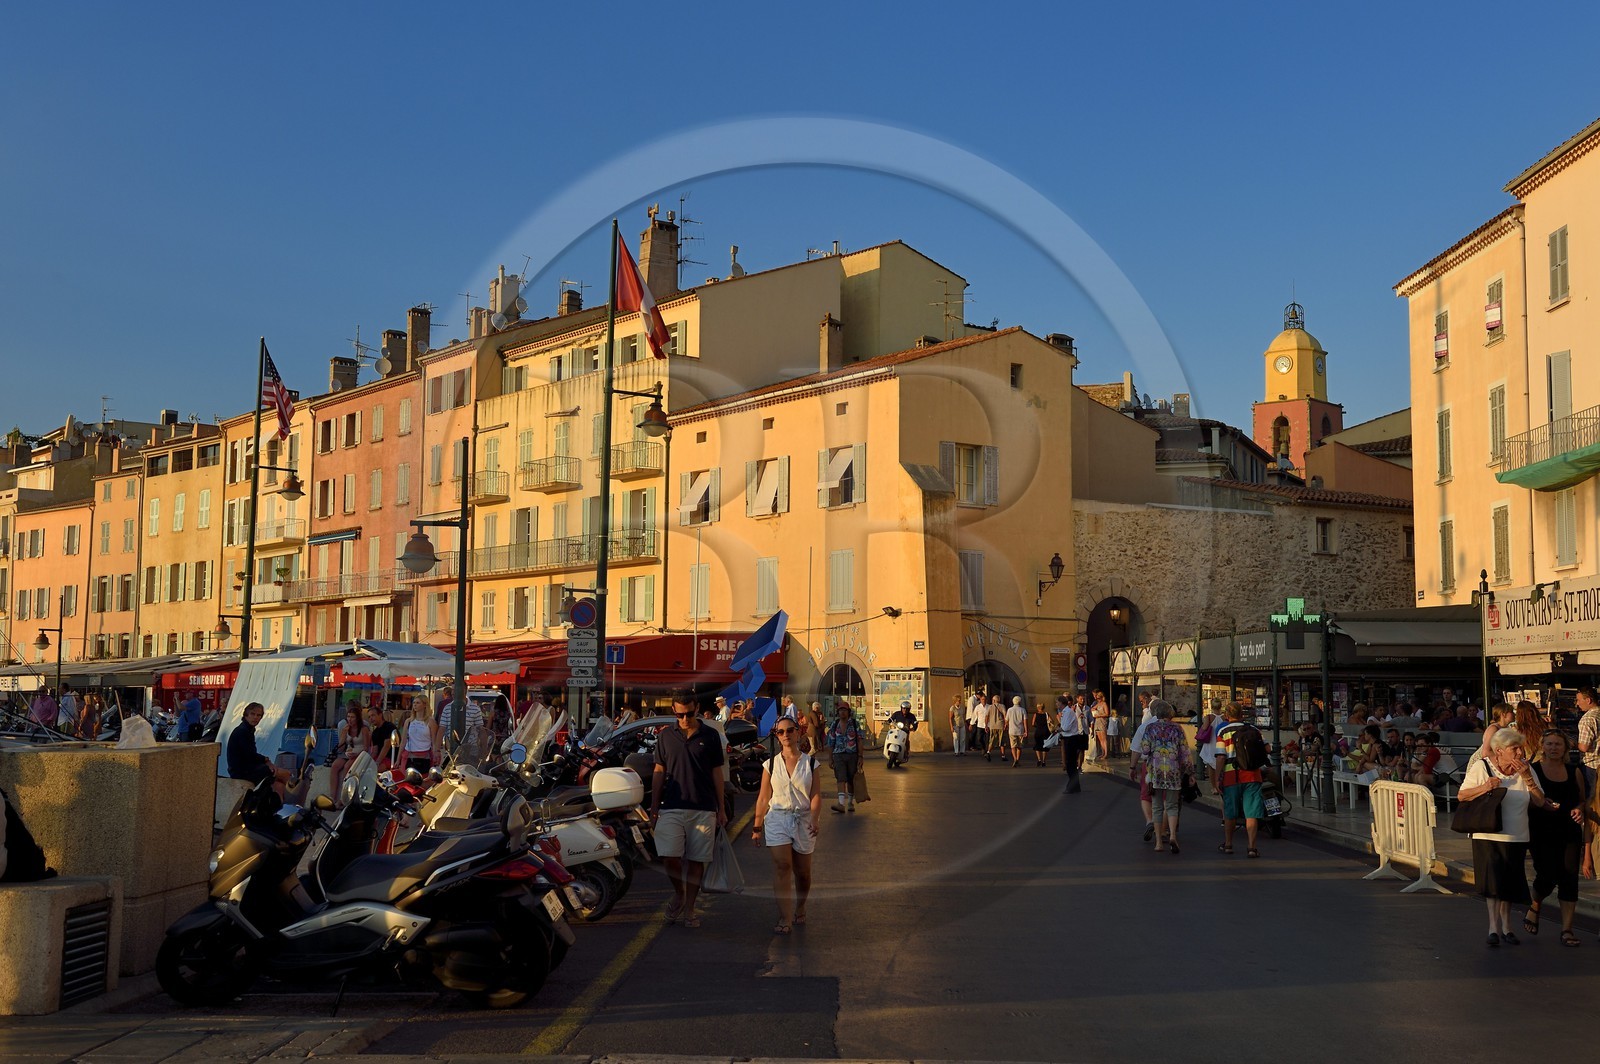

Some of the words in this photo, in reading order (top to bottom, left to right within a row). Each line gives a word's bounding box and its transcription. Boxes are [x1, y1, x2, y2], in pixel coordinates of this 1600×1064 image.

[1505, 594, 1552, 630] SOUVENIRS
[1553, 600, 1562, 620] DE
[1000, 624, 1009, 634] DE
[808, 633, 877, 667] TOURISME
[1239, 642, 1248, 657] bar
[1248, 641, 1255, 656] du
[1255, 640, 1266, 660] port
[188, 674, 226, 685] SENEQUIER
